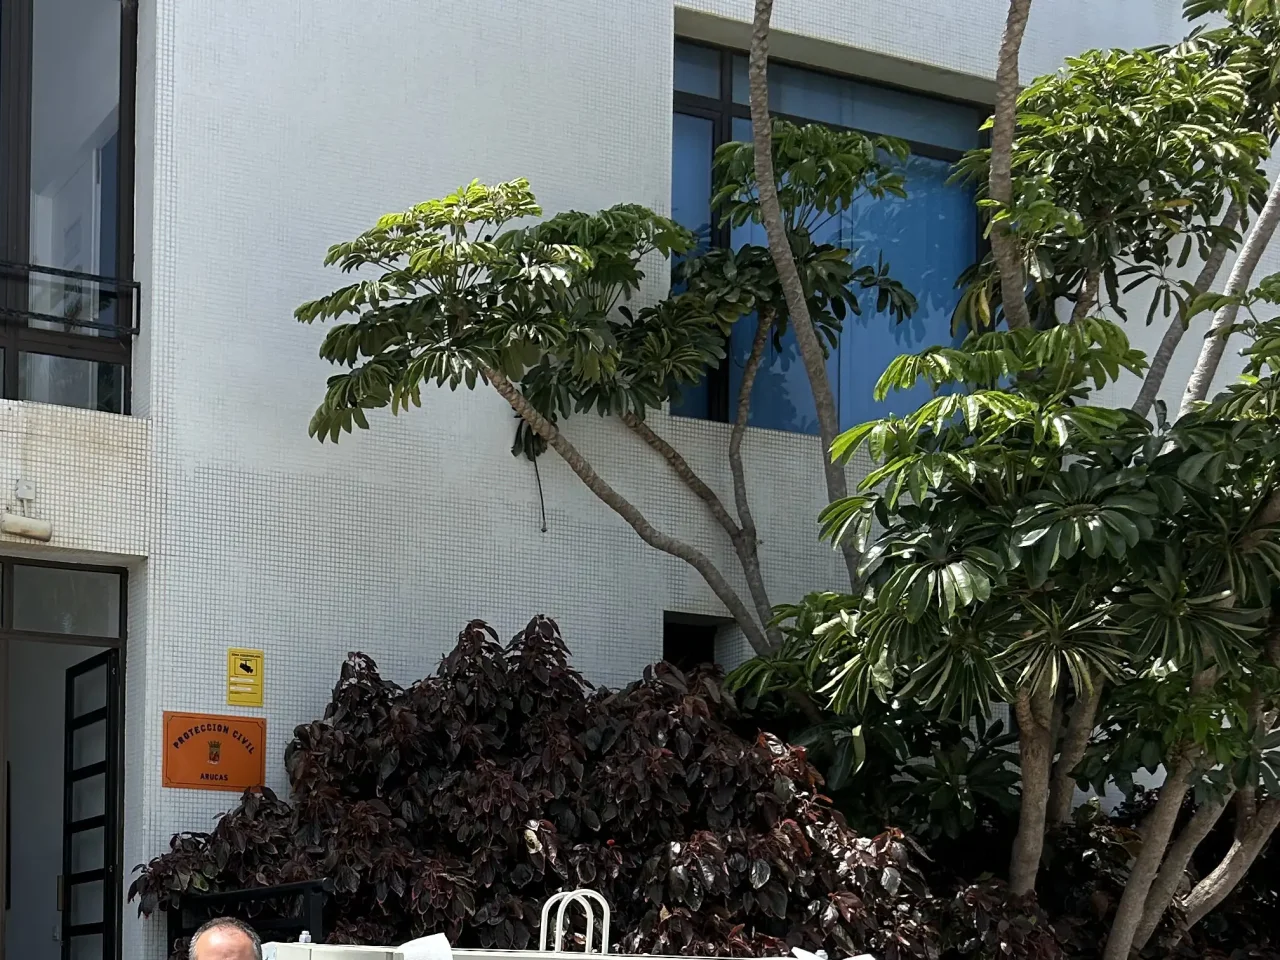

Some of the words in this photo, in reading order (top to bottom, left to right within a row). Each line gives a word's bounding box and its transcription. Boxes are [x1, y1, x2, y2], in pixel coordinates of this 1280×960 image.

[173, 723, 229, 749] PROTECCION
[232, 730, 255, 755] CIVIL
[200, 773, 228, 781] ARUCAS
